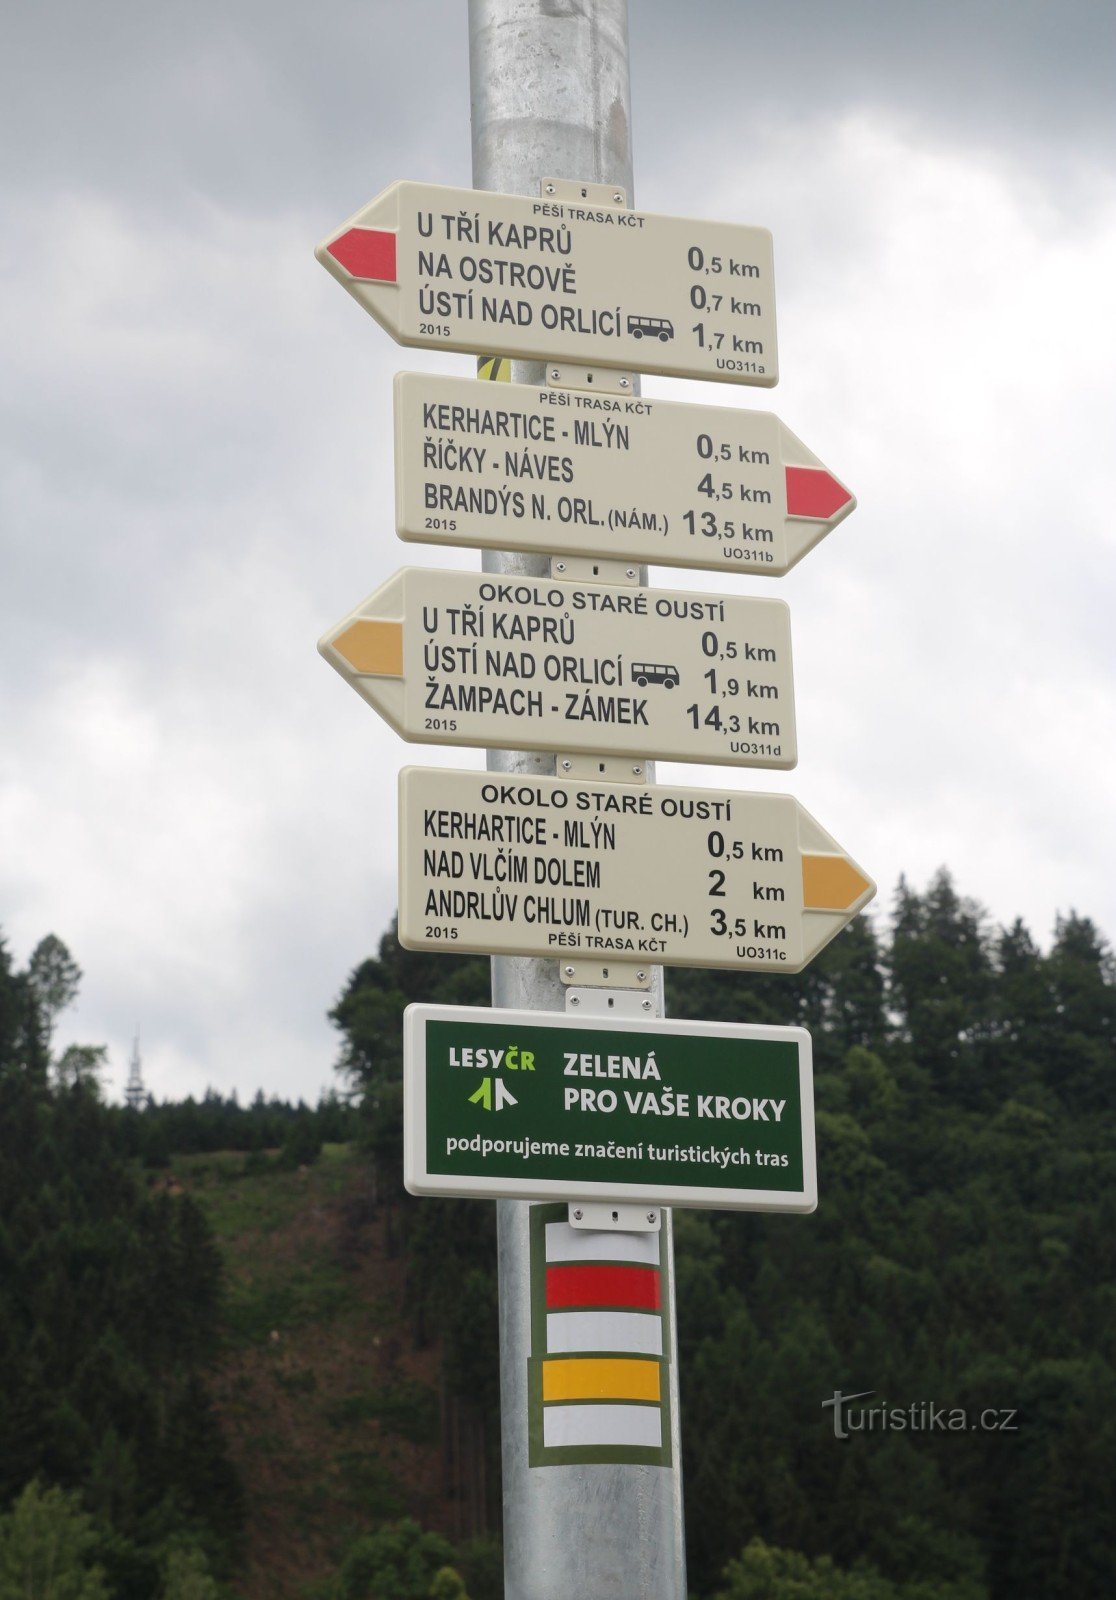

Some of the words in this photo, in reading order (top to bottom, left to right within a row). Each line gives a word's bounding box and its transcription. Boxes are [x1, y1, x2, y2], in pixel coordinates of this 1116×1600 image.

[533, 203, 563, 218] PĚŠÍ
[568, 209, 614, 224] TRASA
[618, 214, 645, 228] KČT
[418, 212, 432, 237] U
[441, 211, 479, 243] TŘÍ
[489, 221, 571, 254] KAPRŮ
[688, 247, 722, 275] 0,5
[730, 259, 759, 278] km
[419, 251, 452, 279] NA
[460, 257, 576, 294] OSTROVĚ
[690, 285, 722, 313] 0,7
[731, 297, 761, 316] km
[420, 284, 473, 319] ÚSTÍ
[482, 297, 532, 326] NAD
[541, 304, 620, 337] ORLICÍ
[693, 323, 724, 351] 1,7
[733, 335, 763, 354] km
[420, 323, 450, 336] 2015
[717, 358, 765, 373] UO311a
[540, 392, 570, 406] PĚŠÍ
[575, 397, 621, 412] TRASA
[625, 401, 653, 416] KČT
[424, 403, 555, 444] KERHARTICE
[574, 418, 629, 450] MLÝN
[697, 434, 731, 462] 0,5
[739, 446, 769, 464] km
[424, 436, 486, 473] ŘÍČKY
[506, 447, 573, 483] NÁVES
[698, 473, 732, 501] 4,5
[741, 484, 771, 503] km
[425, 483, 524, 518] BRANDÝS
[532, 494, 550, 520] N.
[683, 510, 735, 540] 13,5
[743, 523, 773, 542] km
[425, 518, 456, 530] 2015
[724, 547, 773, 562] UO311b
[479, 584, 564, 607] OKOLO
[573, 592, 647, 615] STARÉ
[656, 600, 724, 621] OUSTÍ
[423, 607, 437, 633] U
[446, 604, 483, 637] TŘÍ
[493, 612, 574, 645] KAPRŮ
[702, 632, 737, 660] 0,5
[745, 643, 776, 662] km
[425, 639, 477, 674] ÚSTÍ
[486, 650, 535, 678] NAD
[544, 655, 622, 686] ORLICÍ
[705, 669, 739, 698] 1,9
[747, 680, 778, 699] km
[425, 676, 542, 717] ŽAMPACH
[565, 689, 649, 725] ZÁMEK
[687, 704, 740, 735] 14,3
[749, 717, 779, 735] km
[425, 718, 457, 731] 2015
[731, 742, 781, 756] UO311d
[482, 785, 568, 808] OKOLO
[576, 792, 653, 815] STARÉ
[661, 799, 730, 821] OUSTÍ
[425, 810, 546, 845] KERHARTICE
[565, 816, 615, 850] MLÝN
[708, 831, 743, 861] 0,5
[752, 843, 783, 862] km
[425, 849, 463, 878] NAD
[470, 848, 527, 883] VLČÍM
[535, 857, 600, 888] DOLEM
[709, 870, 725, 896] 2
[753, 882, 784, 901] km
[425, 886, 517, 921] ANDRLŮV
[524, 896, 589, 926] CHLUM
[596, 909, 644, 932] (TUR.
[651, 913, 688, 938] CH.)
[711, 909, 746, 939] 3,5
[754, 920, 785, 939] km
[426, 926, 458, 939] 2015
[549, 932, 580, 946] PĚŠÍ
[585, 936, 634, 950] TRASA
[639, 938, 667, 952] KČT
[737, 946, 786, 960] UO311c
[564, 1051, 661, 1080] ZELENÁ
[565, 1088, 617, 1112] PRO
[624, 1086, 689, 1116] VAŠE
[697, 1095, 786, 1121] KROKY
[447, 1134, 569, 1159] podporujeme
[575, 1141, 643, 1159] značení
[647, 1144, 750, 1168] turistických
[755, 1150, 788, 1167] tras
